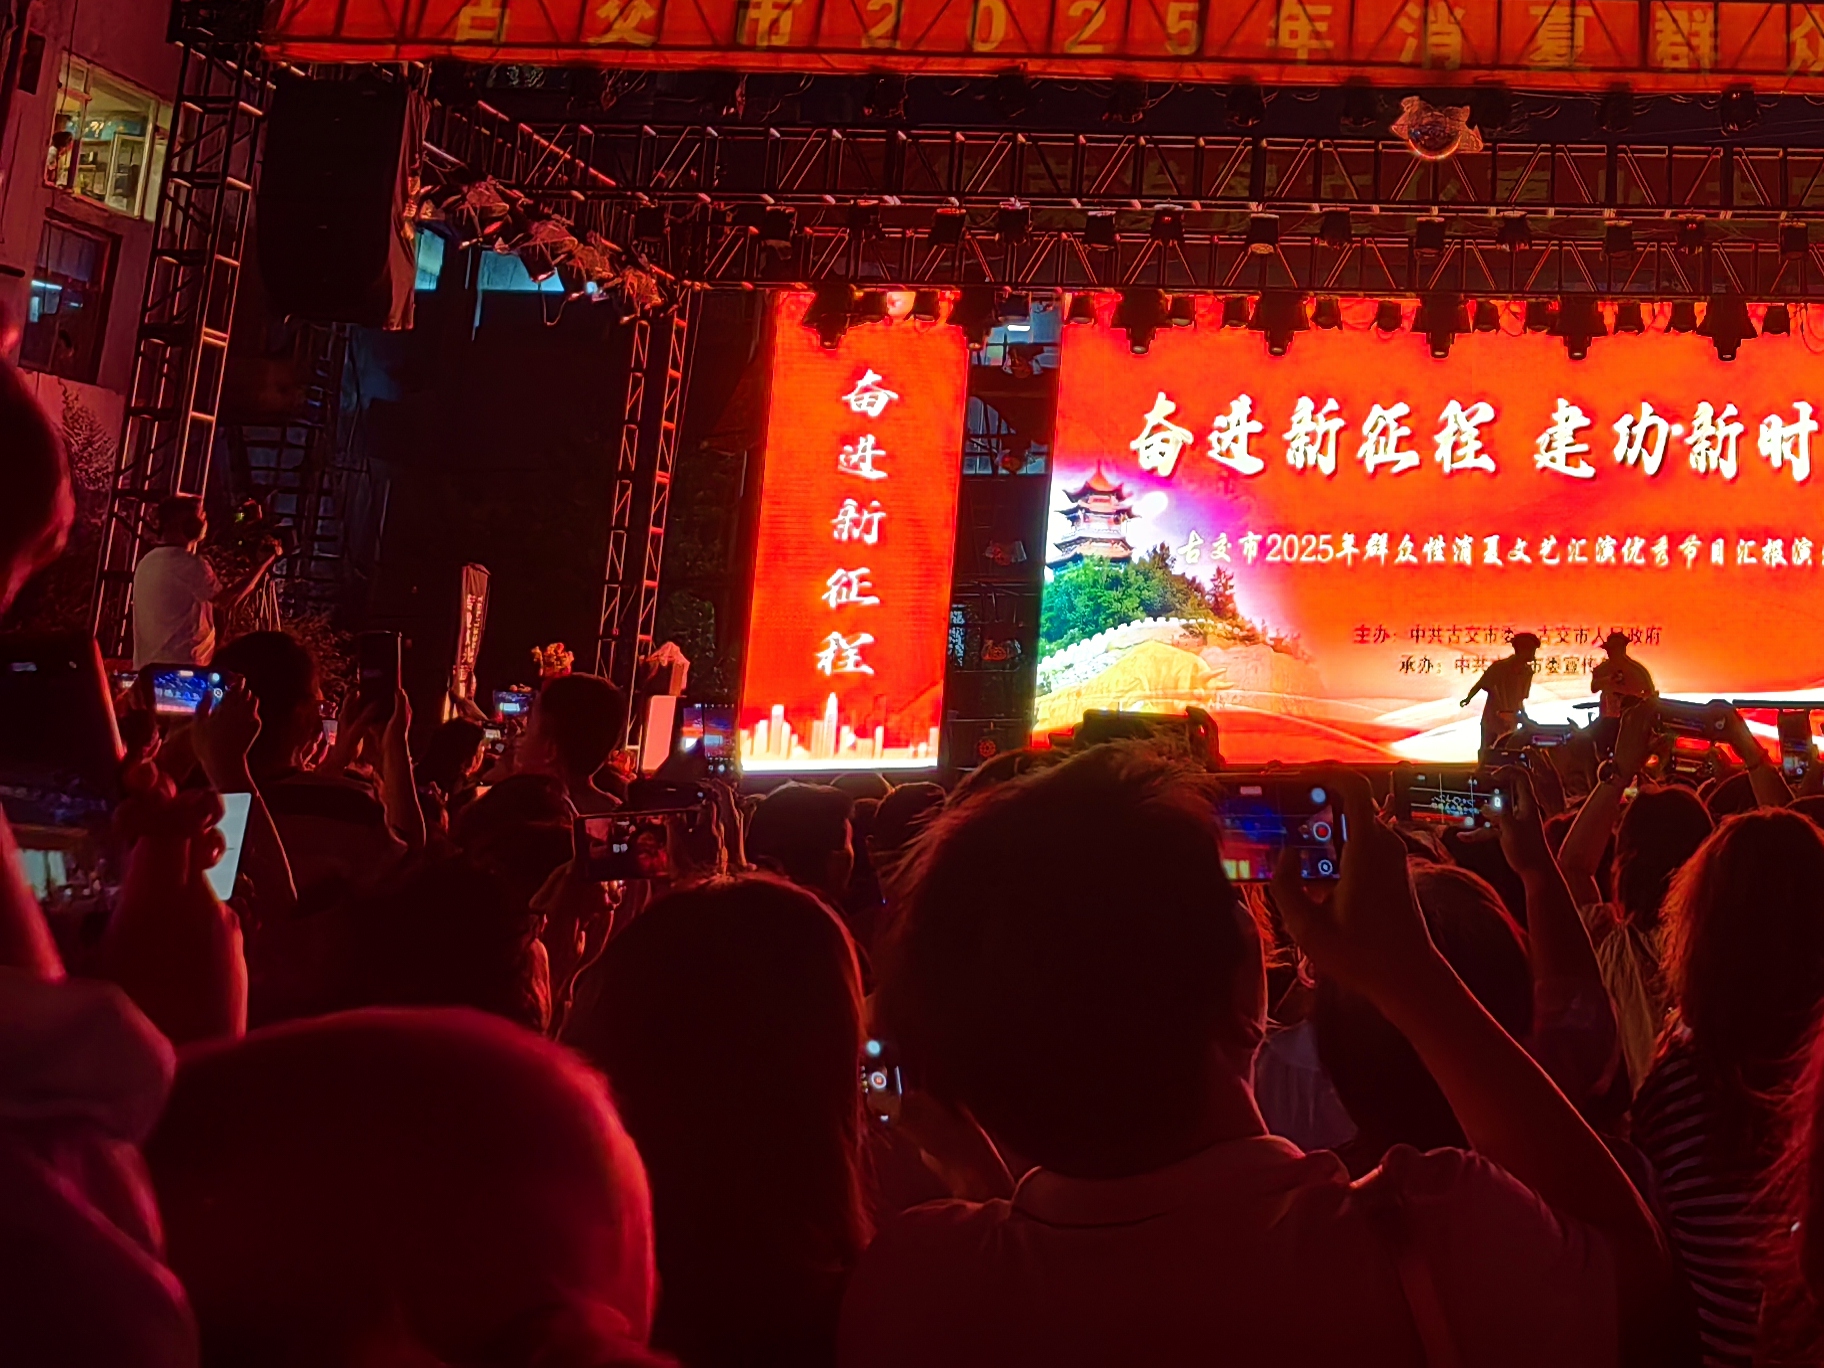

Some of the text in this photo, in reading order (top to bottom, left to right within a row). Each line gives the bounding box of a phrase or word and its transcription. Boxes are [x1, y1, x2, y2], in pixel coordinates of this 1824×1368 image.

[813, 368, 899, 678] 奋进新征程
[1129, 390, 1499, 478] 奋进新征程
